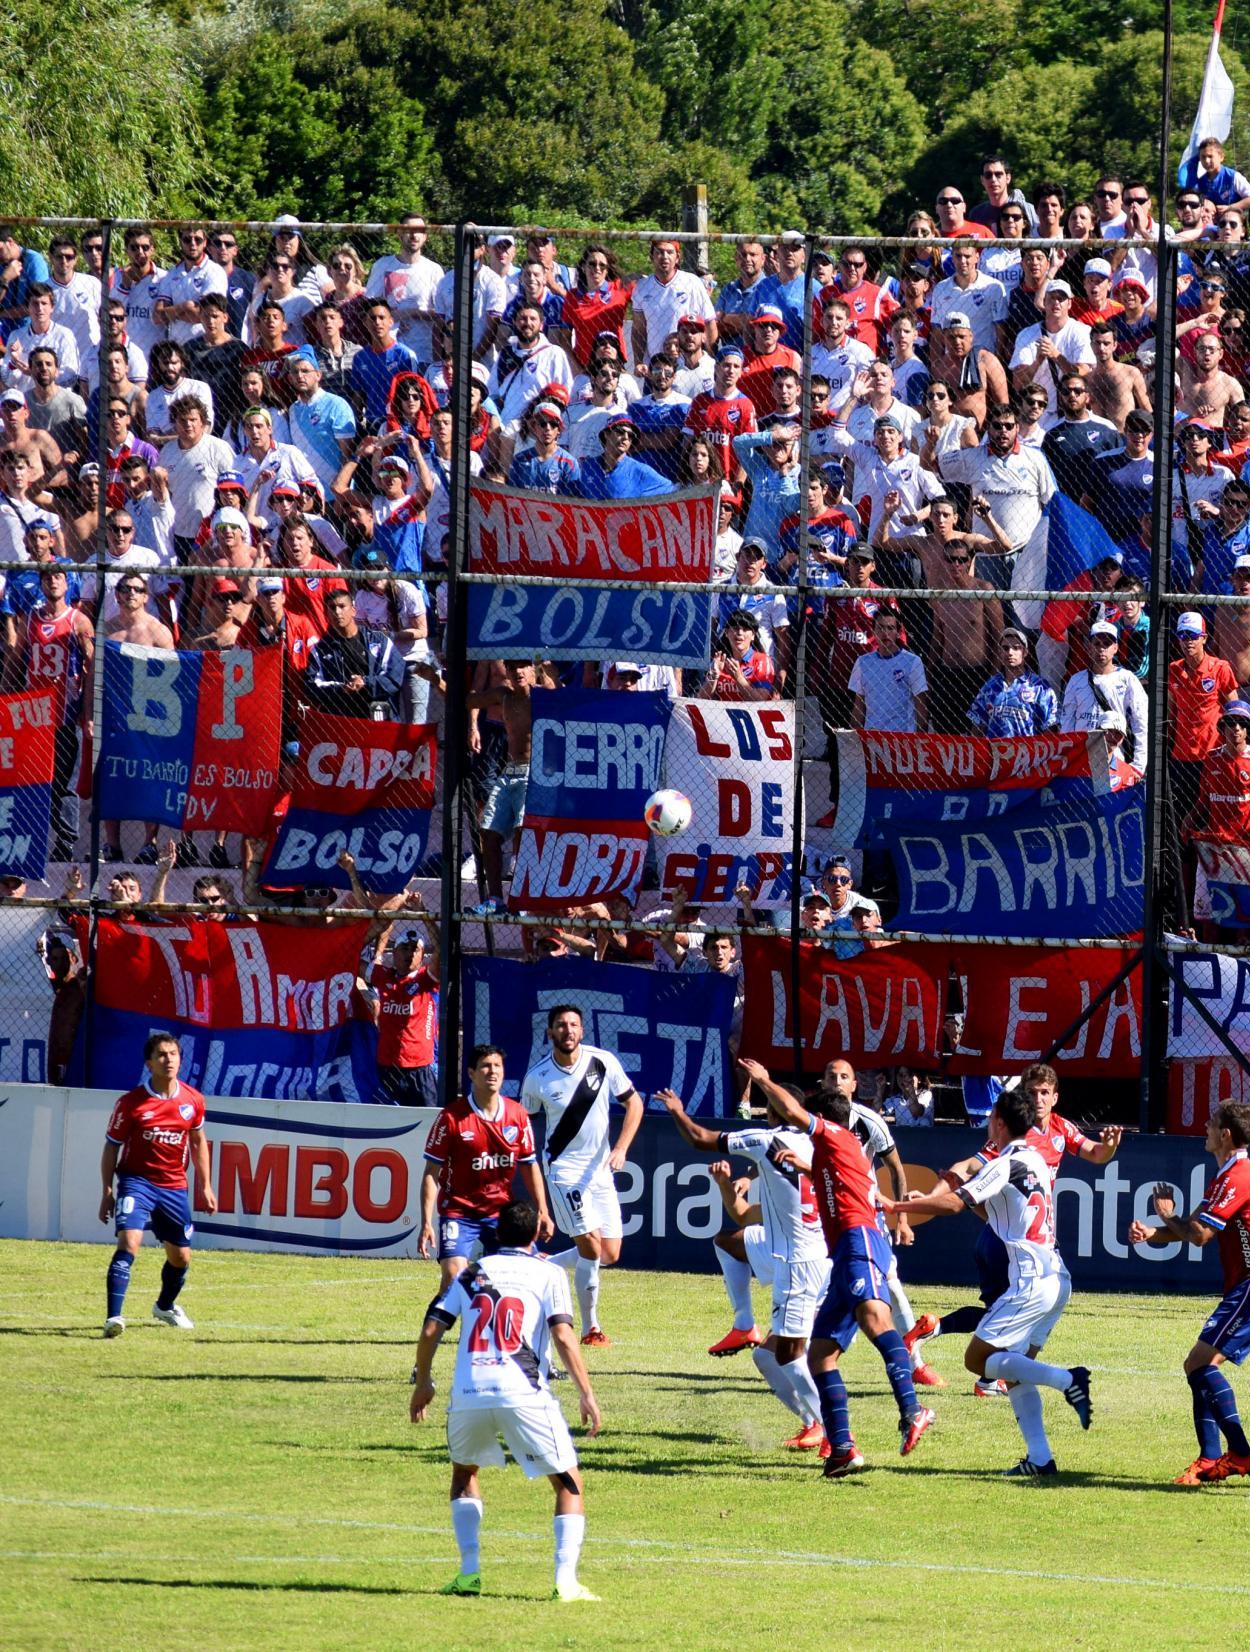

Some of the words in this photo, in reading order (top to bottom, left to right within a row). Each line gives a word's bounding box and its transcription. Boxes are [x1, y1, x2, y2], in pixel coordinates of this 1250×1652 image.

[469, 497, 710, 573] MARACANA
[793, 567, 829, 581] ACEL
[478, 583, 697, 650] BOLSO
[838, 627, 867, 645] antel
[31, 643, 65, 678] 13
[120, 643, 183, 738] B
[211, 648, 255, 739] P
[531, 719, 664, 793] CERRO
[686, 704, 792, 762] LOS
[866, 736, 974, 777] NUEVO
[106, 756, 137, 778] TU
[194, 765, 218, 786] ES
[222, 767, 273, 789] BOLSO
[718, 779, 784, 838] DE
[275, 827, 421, 875] BOLSO
[899, 808, 1146, 915] BARRIO
[382, 1000, 413, 1016] antel
[142, 1127, 184, 1145] antel
[472, 1152, 515, 1171] antel
[194, 1138, 408, 1224] IMBO
[560, 1161, 723, 1239] era
[822, 1168, 836, 1217] redpagos
[1052, 1160, 1205, 1262] ntel
[467, 1294, 525, 1354] 20
